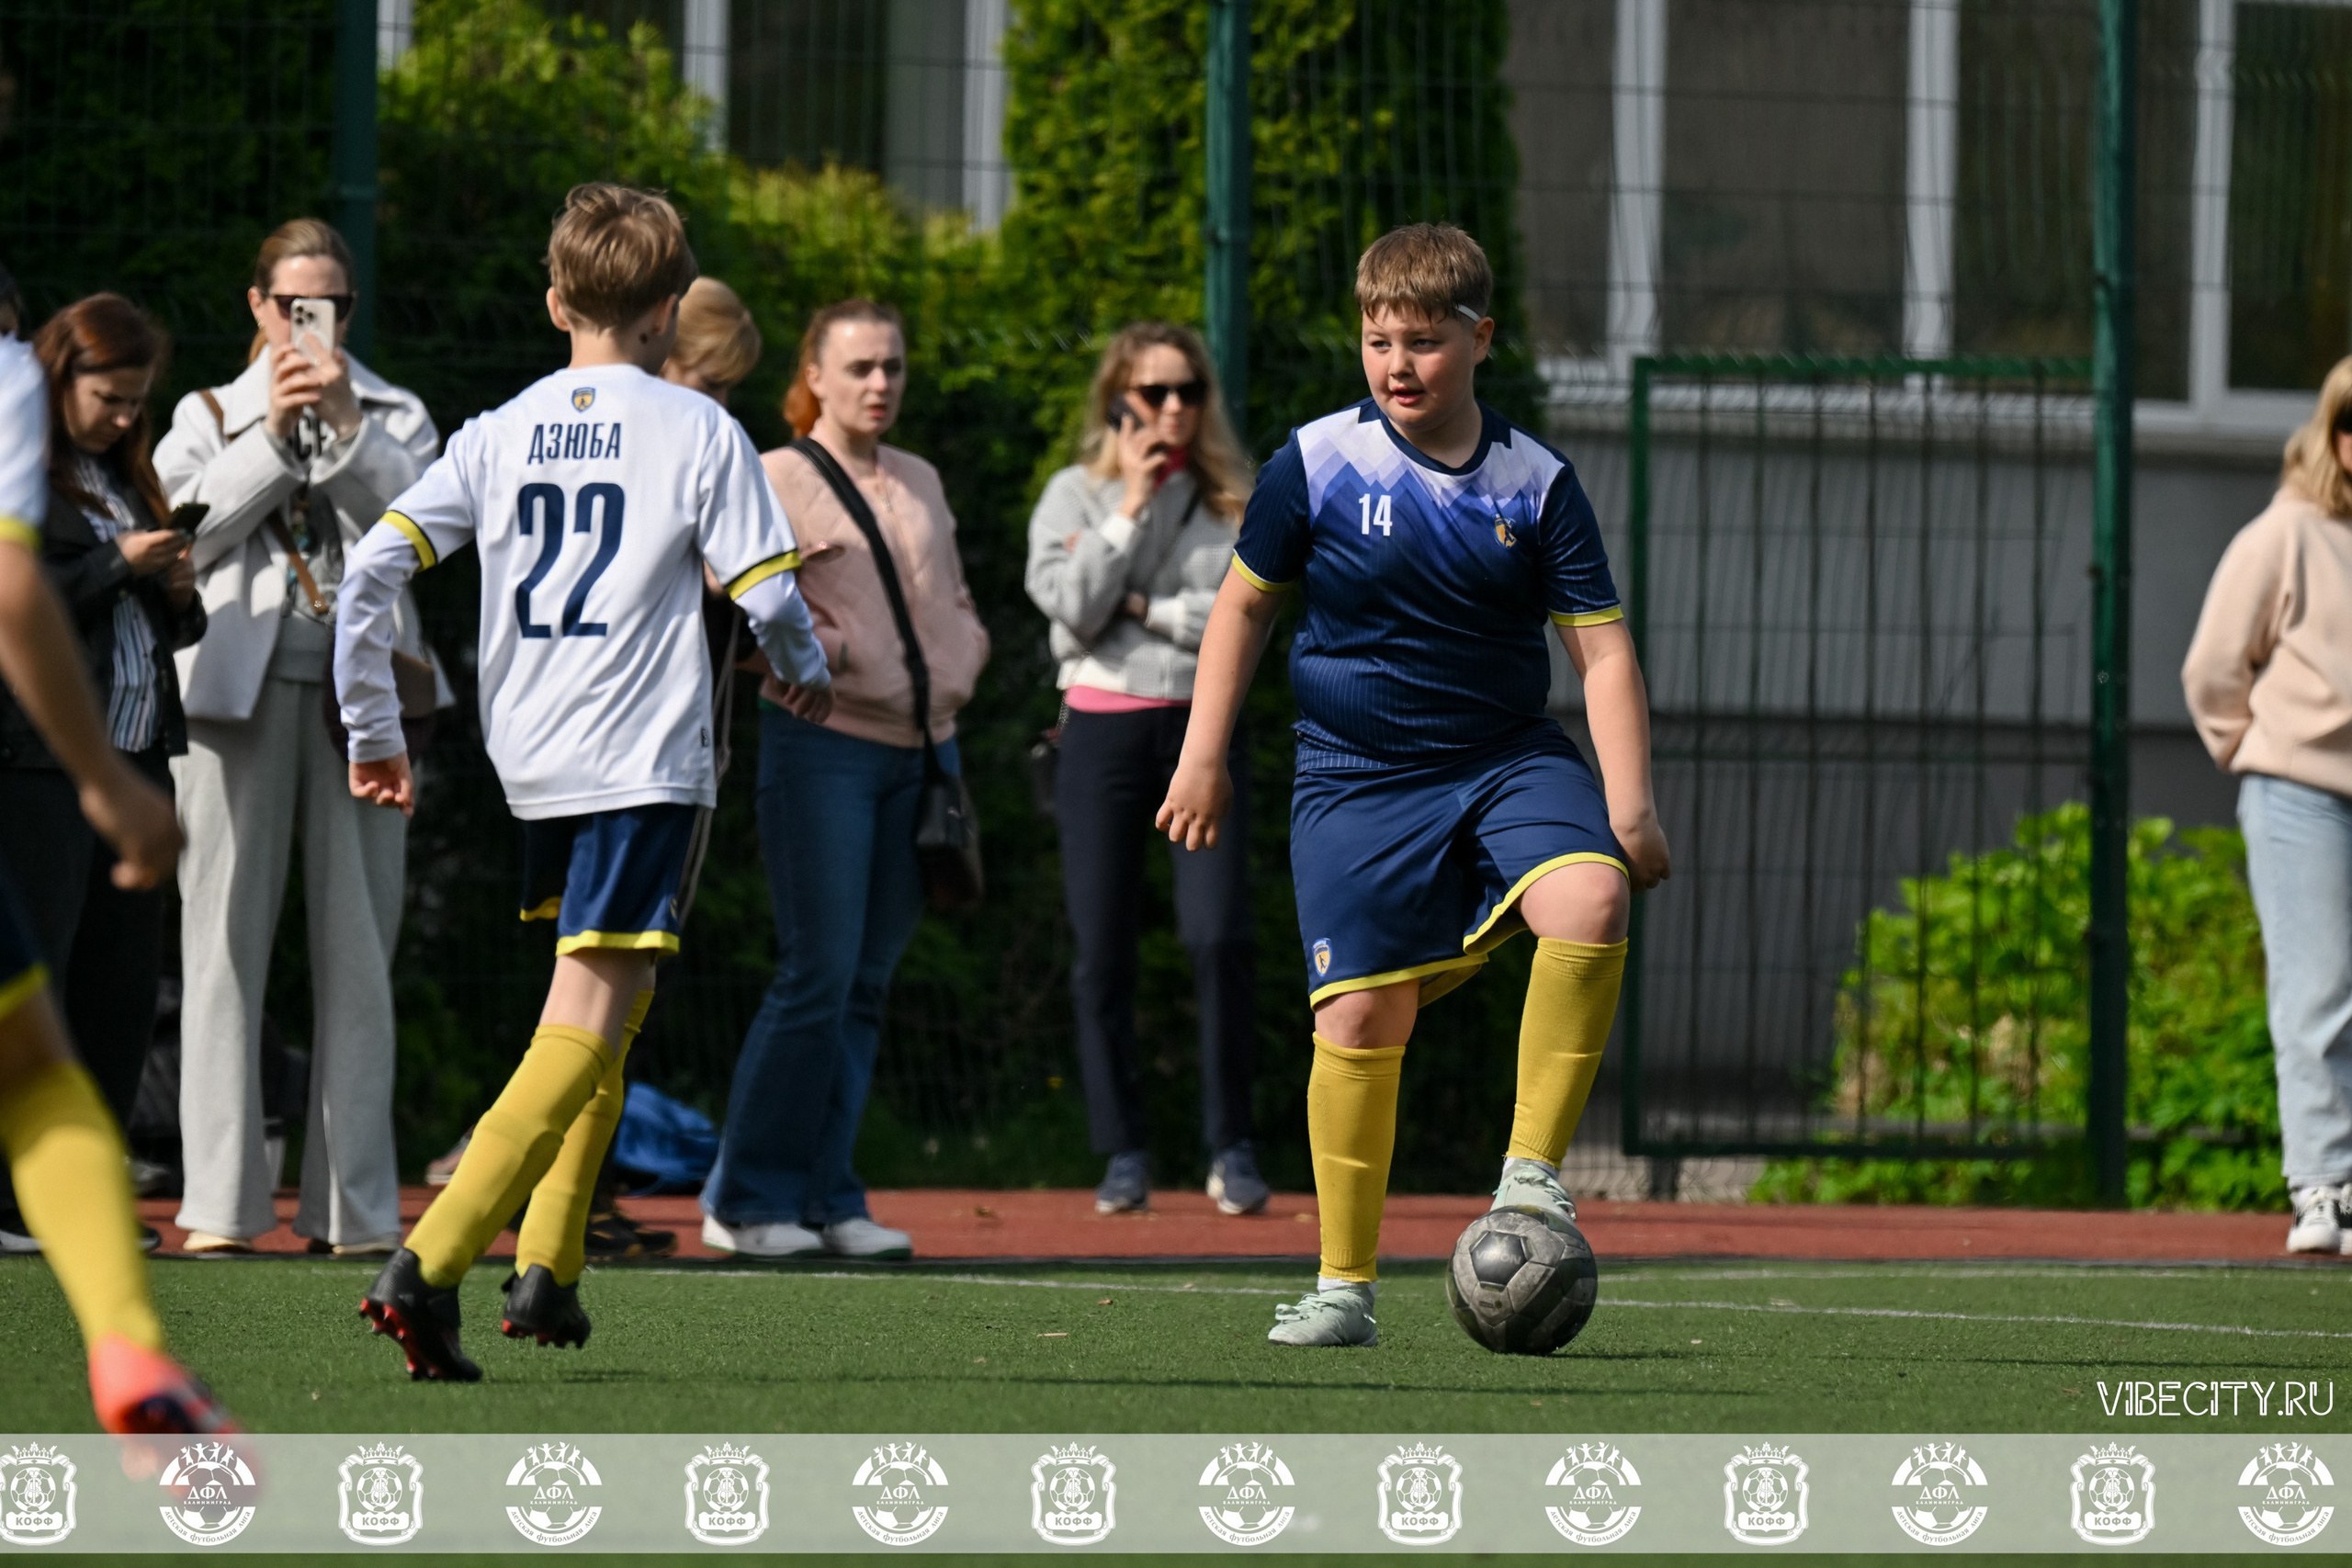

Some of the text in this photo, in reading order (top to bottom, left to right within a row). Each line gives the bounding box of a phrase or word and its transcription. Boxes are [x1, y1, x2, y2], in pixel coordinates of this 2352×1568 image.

[527, 423, 621, 465] ДЗЮБА
[1359, 493, 1393, 536] 14
[515, 482, 625, 638] 22
